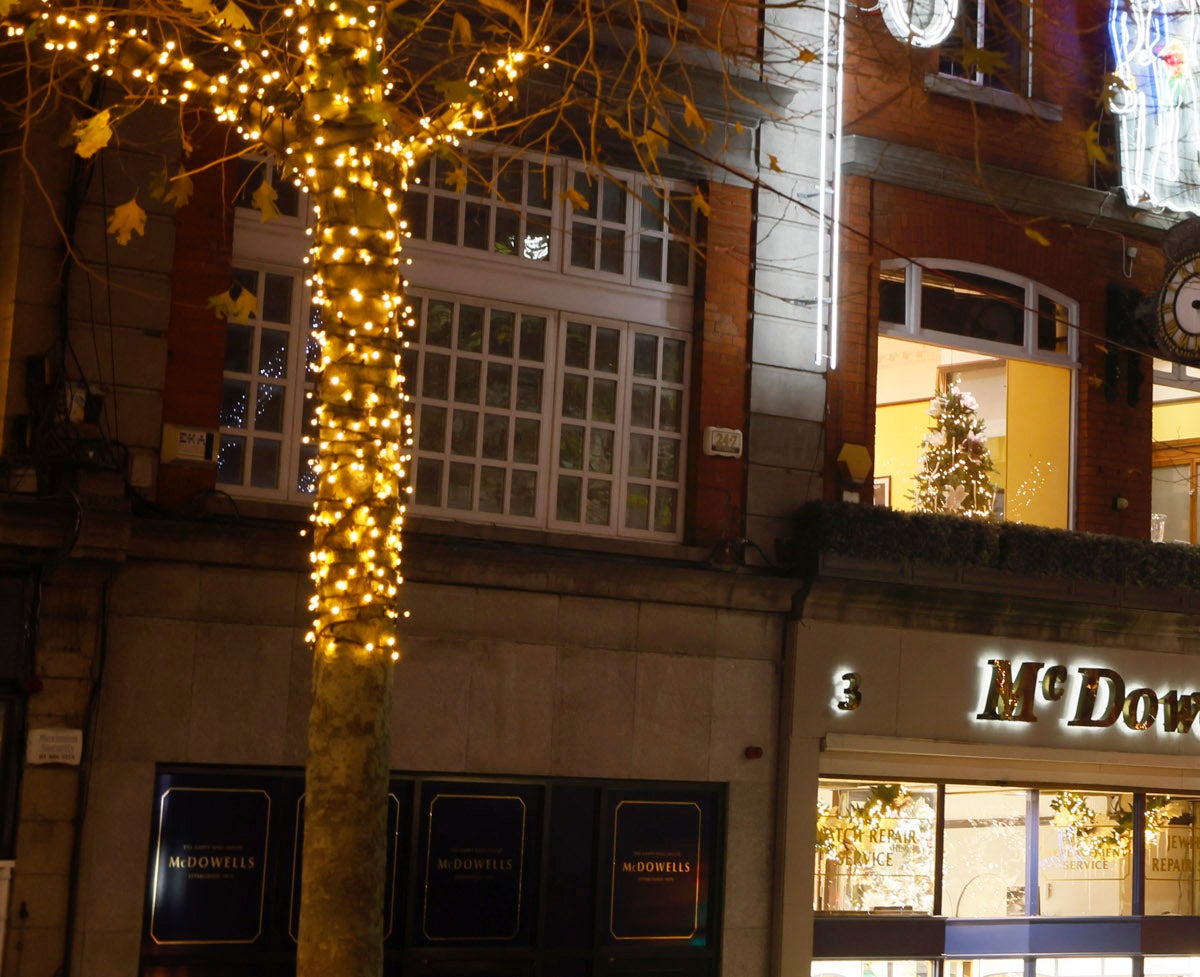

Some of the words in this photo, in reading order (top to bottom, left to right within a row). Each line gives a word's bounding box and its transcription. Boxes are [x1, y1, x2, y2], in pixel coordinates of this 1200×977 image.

[179, 432, 206, 446] EKA
[836, 670, 863, 712] 3
[869, 827, 918, 844] REPAIR
[168, 855, 255, 869] McDOWELLS
[436, 857, 514, 871] McDOWELLS
[836, 850, 894, 867] SERVICE
[1063, 860, 1109, 870] SERVICE
[1152, 857, 1193, 872] REPAIR
[623, 860, 692, 873] McDOWELLS
